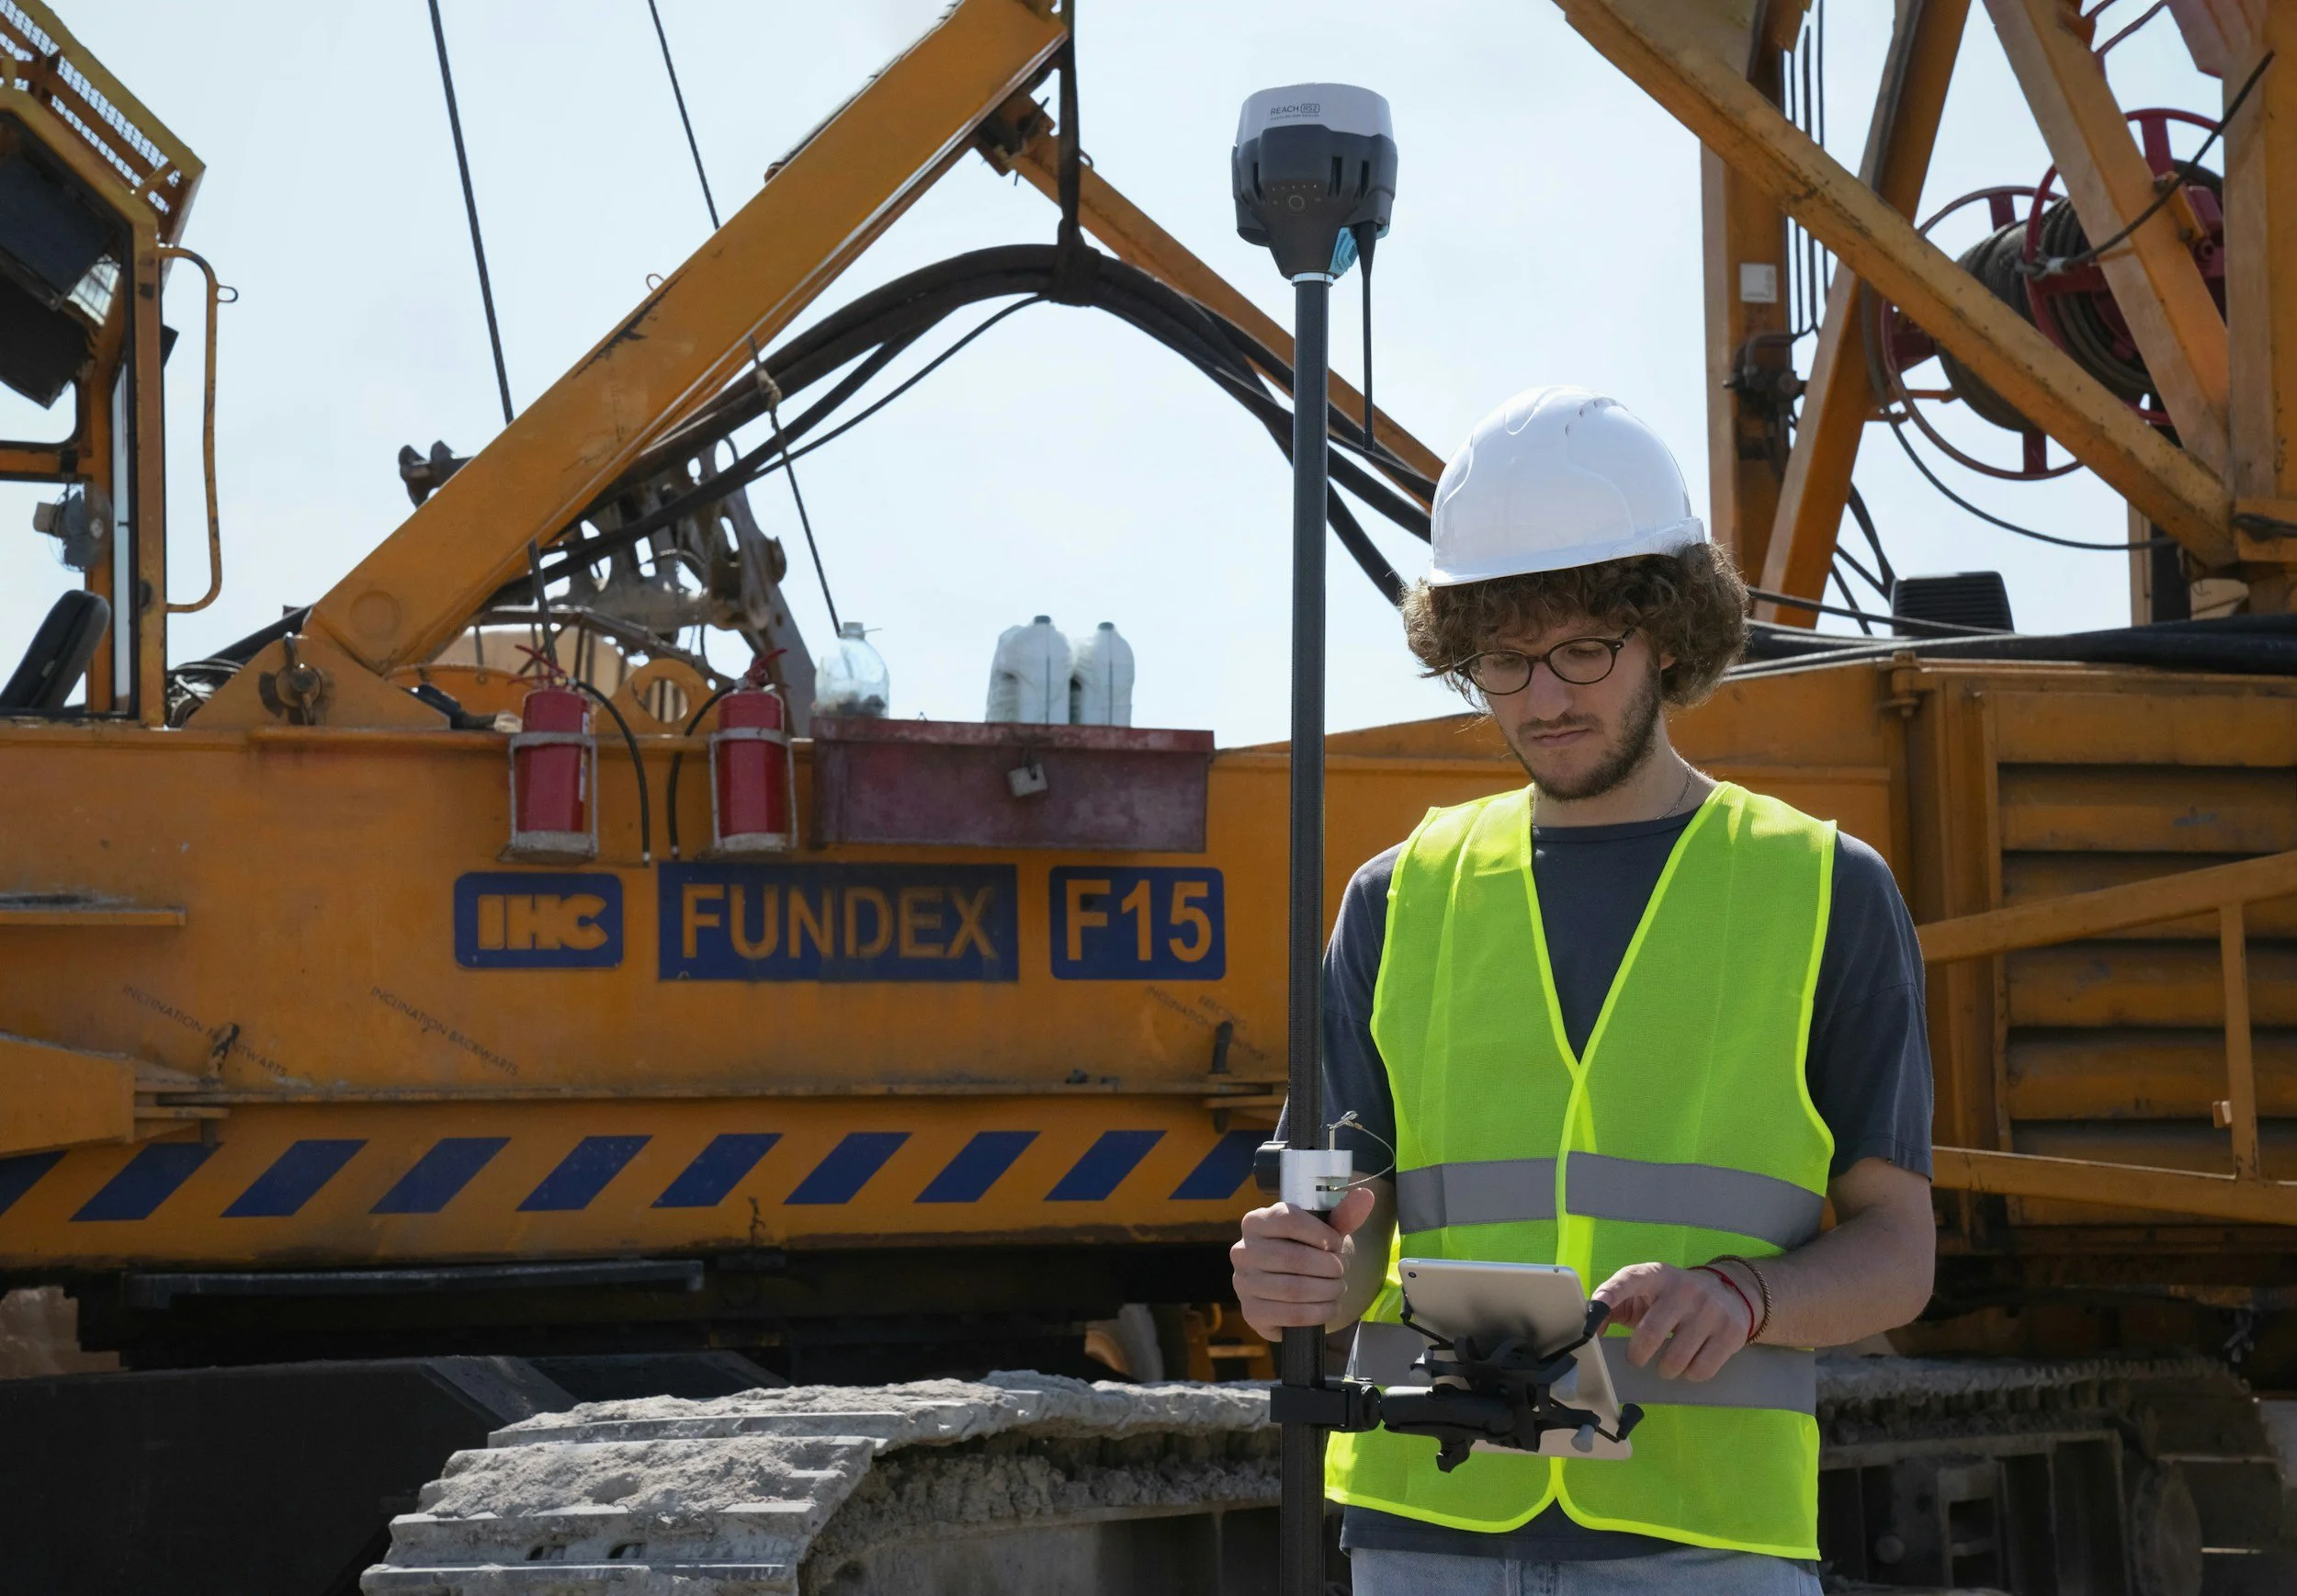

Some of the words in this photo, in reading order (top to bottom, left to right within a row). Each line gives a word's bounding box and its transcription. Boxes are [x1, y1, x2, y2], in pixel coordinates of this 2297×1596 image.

[1270, 105, 1299, 115] REACH
[1301, 105, 1318, 113] RS2
[477, 892, 608, 950] IHC
[682, 883, 999, 960] FUNDEX
[1066, 879, 1214, 963] F15
[370, 985, 448, 1036] INCLINATION
